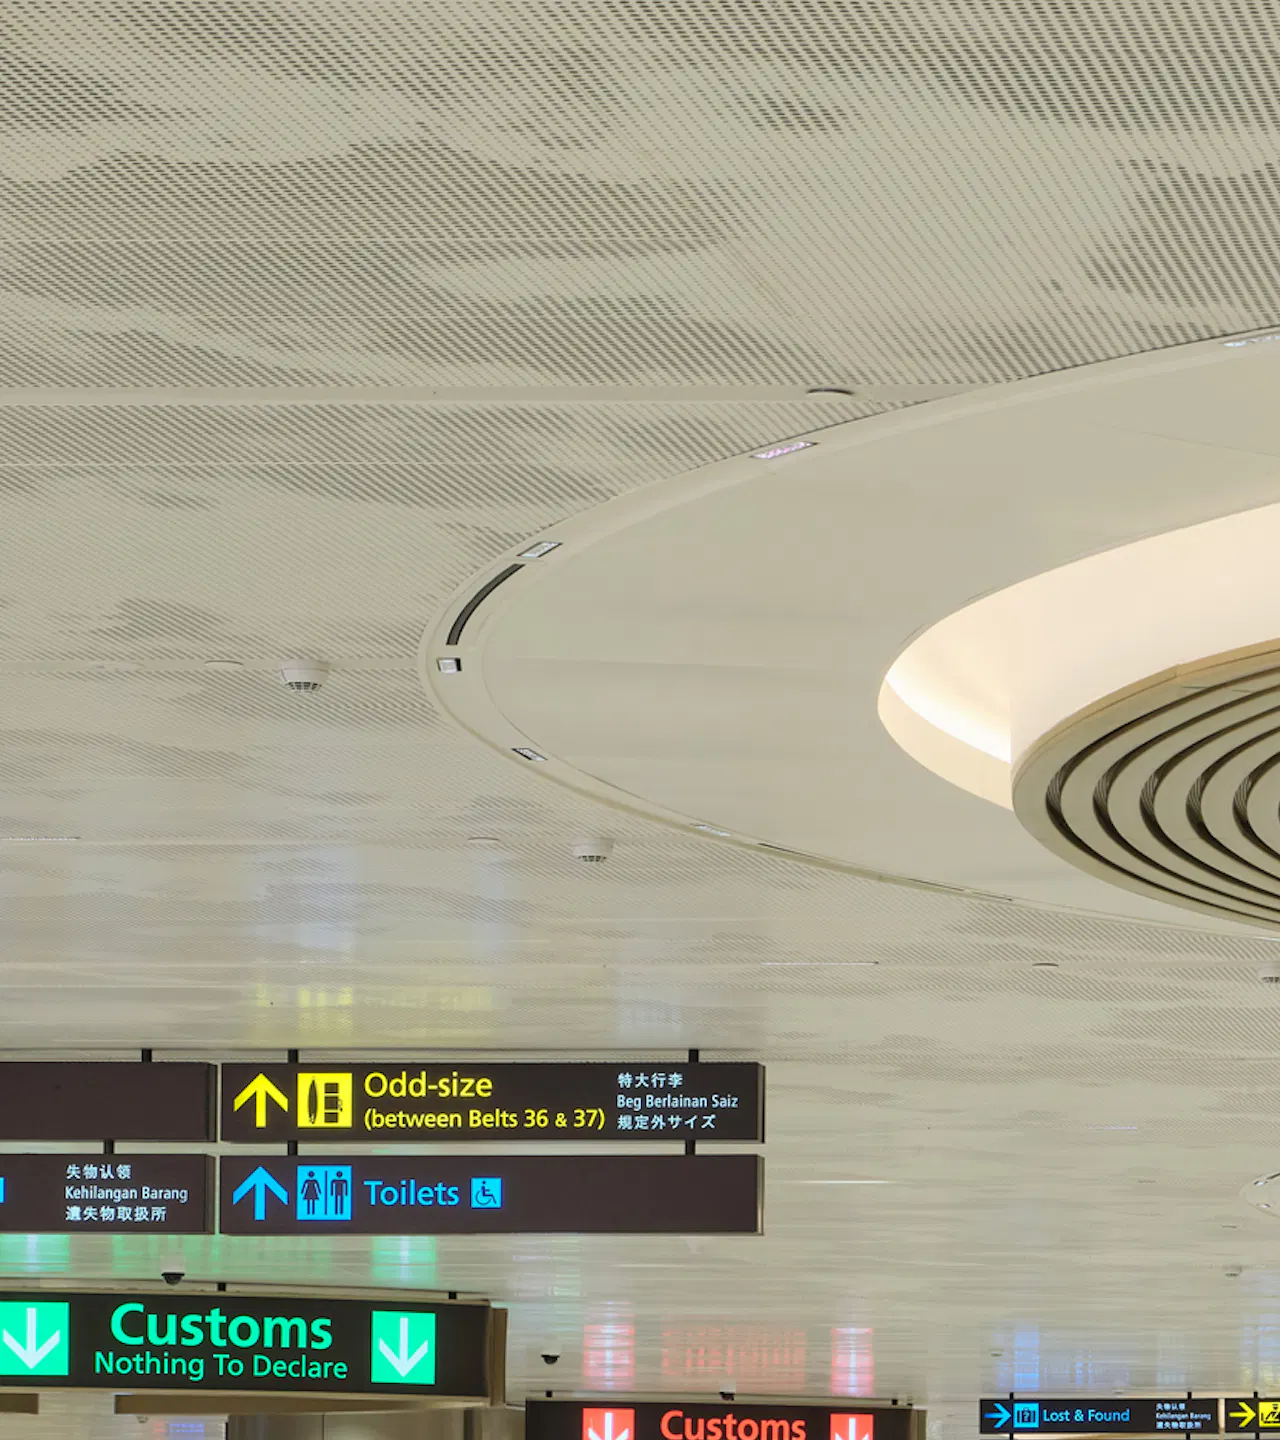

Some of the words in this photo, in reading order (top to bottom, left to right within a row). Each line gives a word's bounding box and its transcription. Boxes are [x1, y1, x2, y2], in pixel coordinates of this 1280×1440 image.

[364, 1070, 493, 1098] Odd-size
[617, 1072, 684, 1089] 特大行李
[616, 1093, 642, 1110] Beg
[645, 1093, 708, 1109] Berlainan
[711, 1093, 739, 1109] Saiz
[364, 1108, 462, 1132] (between
[469, 1108, 518, 1128] Belts
[523, 1108, 549, 1128] 36
[555, 1110, 568, 1128] &
[573, 1108, 606, 1132] 37)
[617, 1114, 716, 1131] 規定外サイズ
[66, 1163, 132, 1180] 失物认领
[65, 1185, 138, 1203] Kehilangan
[142, 1185, 189, 1203] Barang
[363, 1178, 461, 1207] Toilets
[65, 1205, 167, 1222] 遺失物取扱所
[110, 1302, 333, 1350] Customs
[94, 1350, 204, 1382] Nothing
[213, 1353, 244, 1377] To
[253, 1355, 349, 1380] Declare
[1043, 1408, 1071, 1422] Lost
[1074, 1409, 1084, 1422] &
[1087, 1408, 1130, 1422] Found
